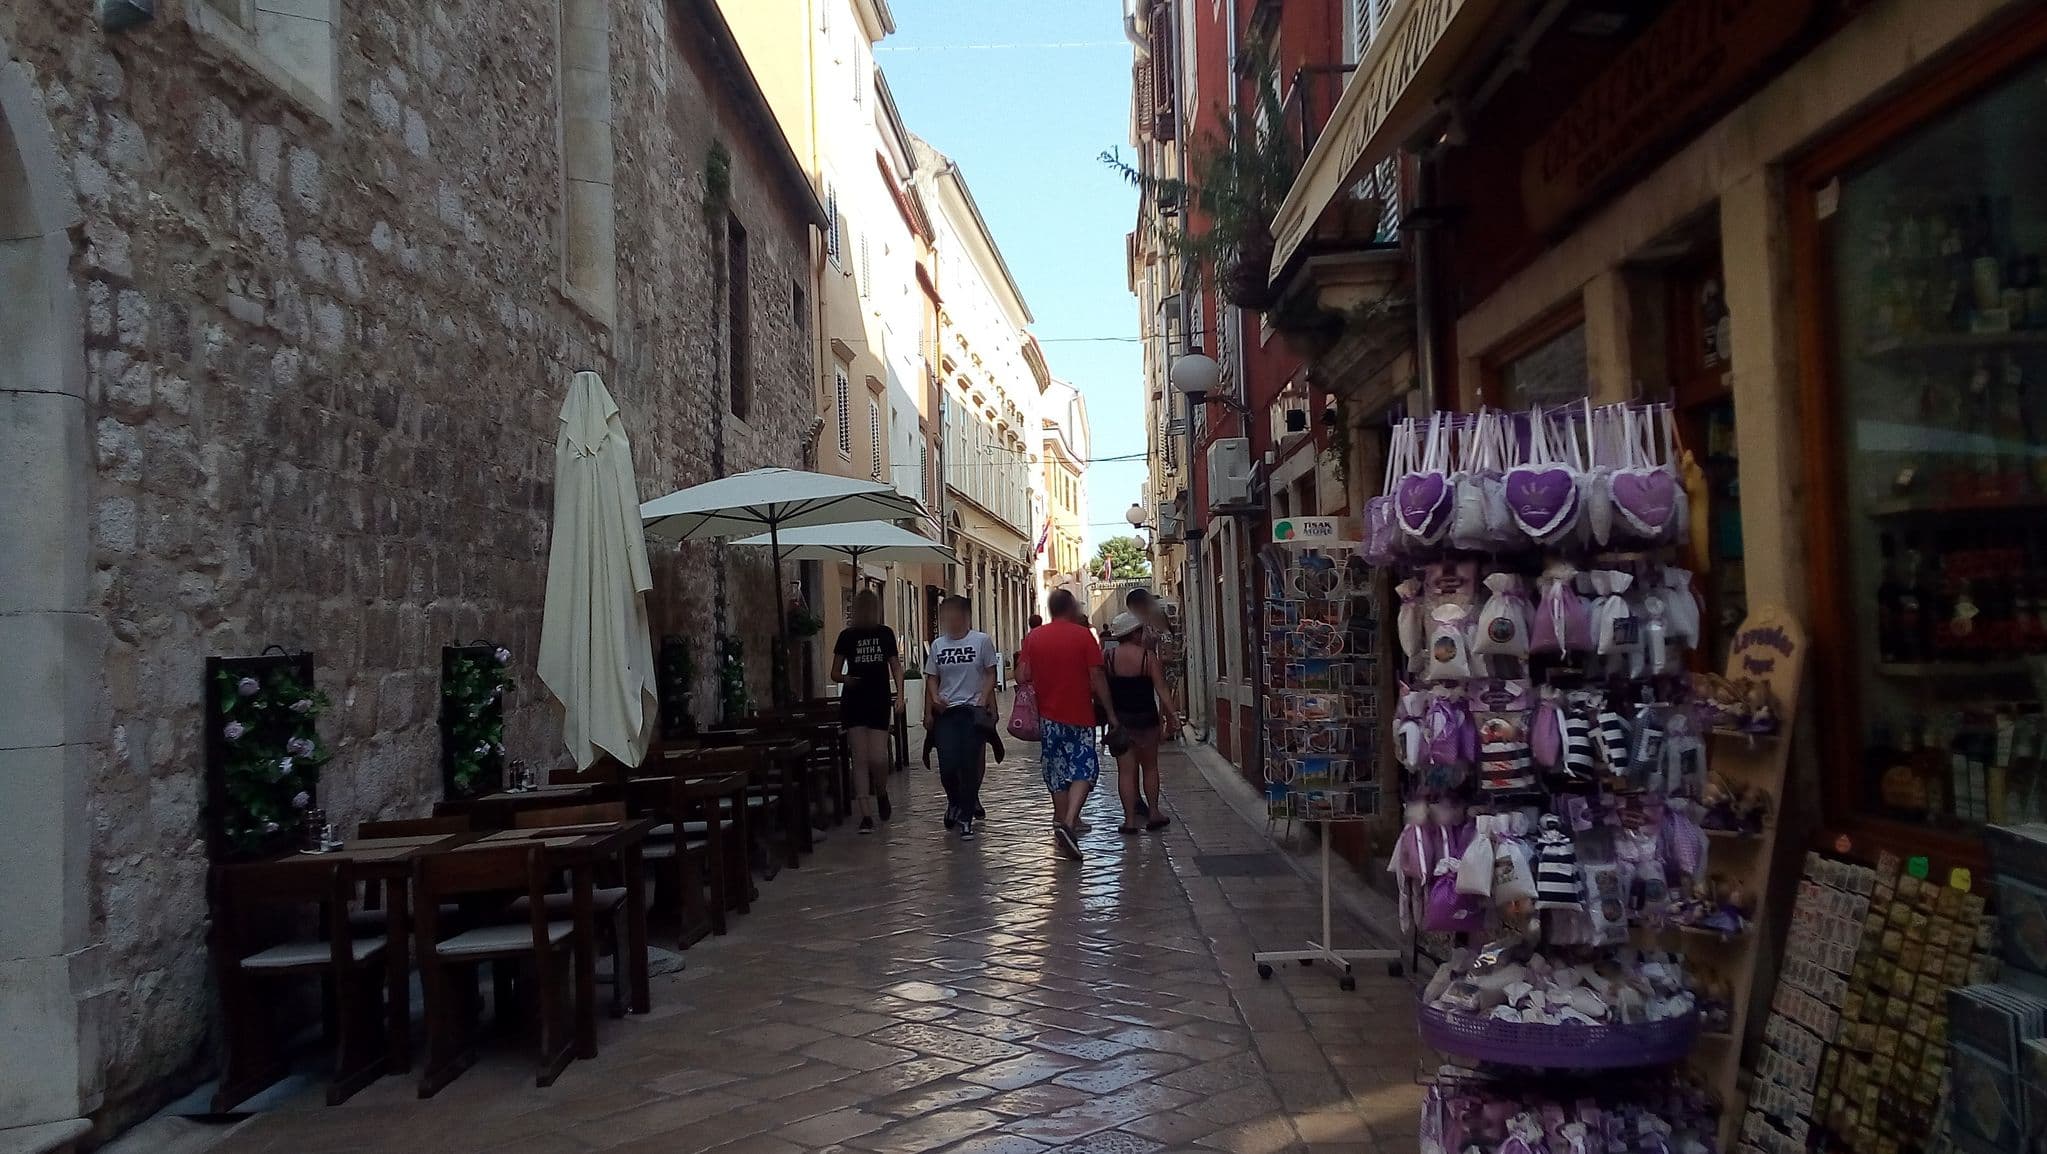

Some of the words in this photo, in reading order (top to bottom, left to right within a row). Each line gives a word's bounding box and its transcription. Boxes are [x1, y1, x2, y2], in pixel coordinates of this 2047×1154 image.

[1303, 521, 1332, 529] TISAK
[1303, 528, 1333, 536] MORE
[856, 646, 875, 654] WITH
[937, 646, 976, 656] STAR
[937, 655, 976, 665] WARS
